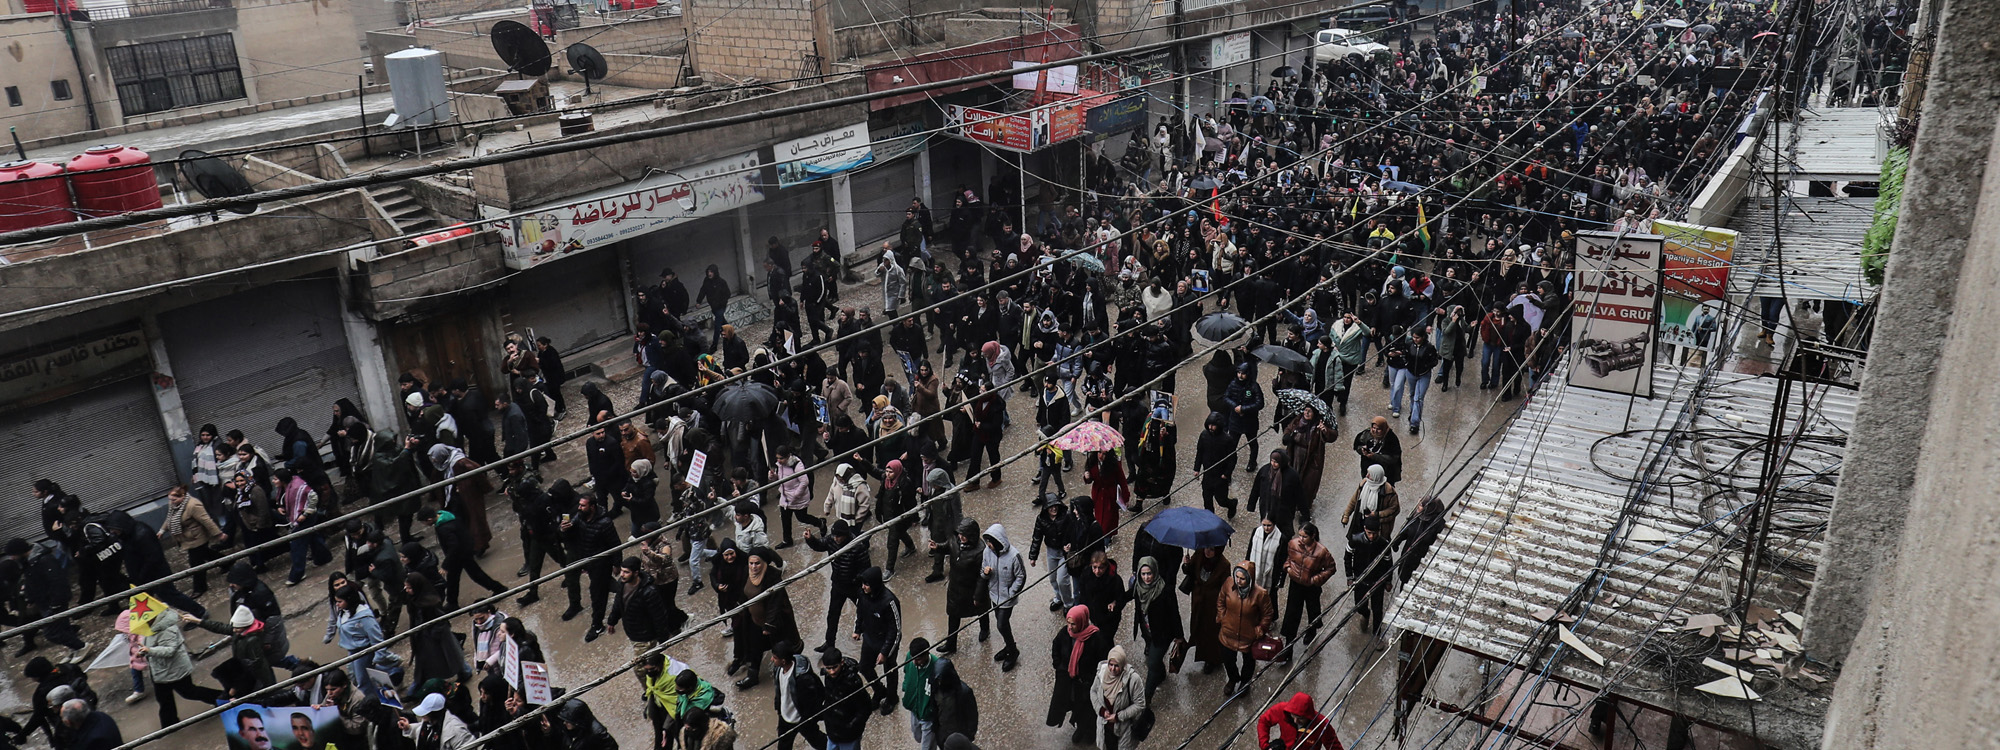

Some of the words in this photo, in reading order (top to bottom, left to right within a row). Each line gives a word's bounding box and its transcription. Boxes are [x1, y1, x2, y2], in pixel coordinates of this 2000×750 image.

[948, 105, 957, 118] R
[964, 110, 994, 124] اتصالات
[1114, 102, 1143, 120] مكتبة
[821, 130, 855, 147] معرض
[964, 125, 994, 139] رامان
[790, 140, 819, 155] جان
[645, 183, 690, 211] عمار
[567, 191, 641, 226] للرياضة
[1574, 303, 1617, 317] MALVA
[93, 335, 141, 360] مكتب
[45, 344, 89, 375] قاسم
